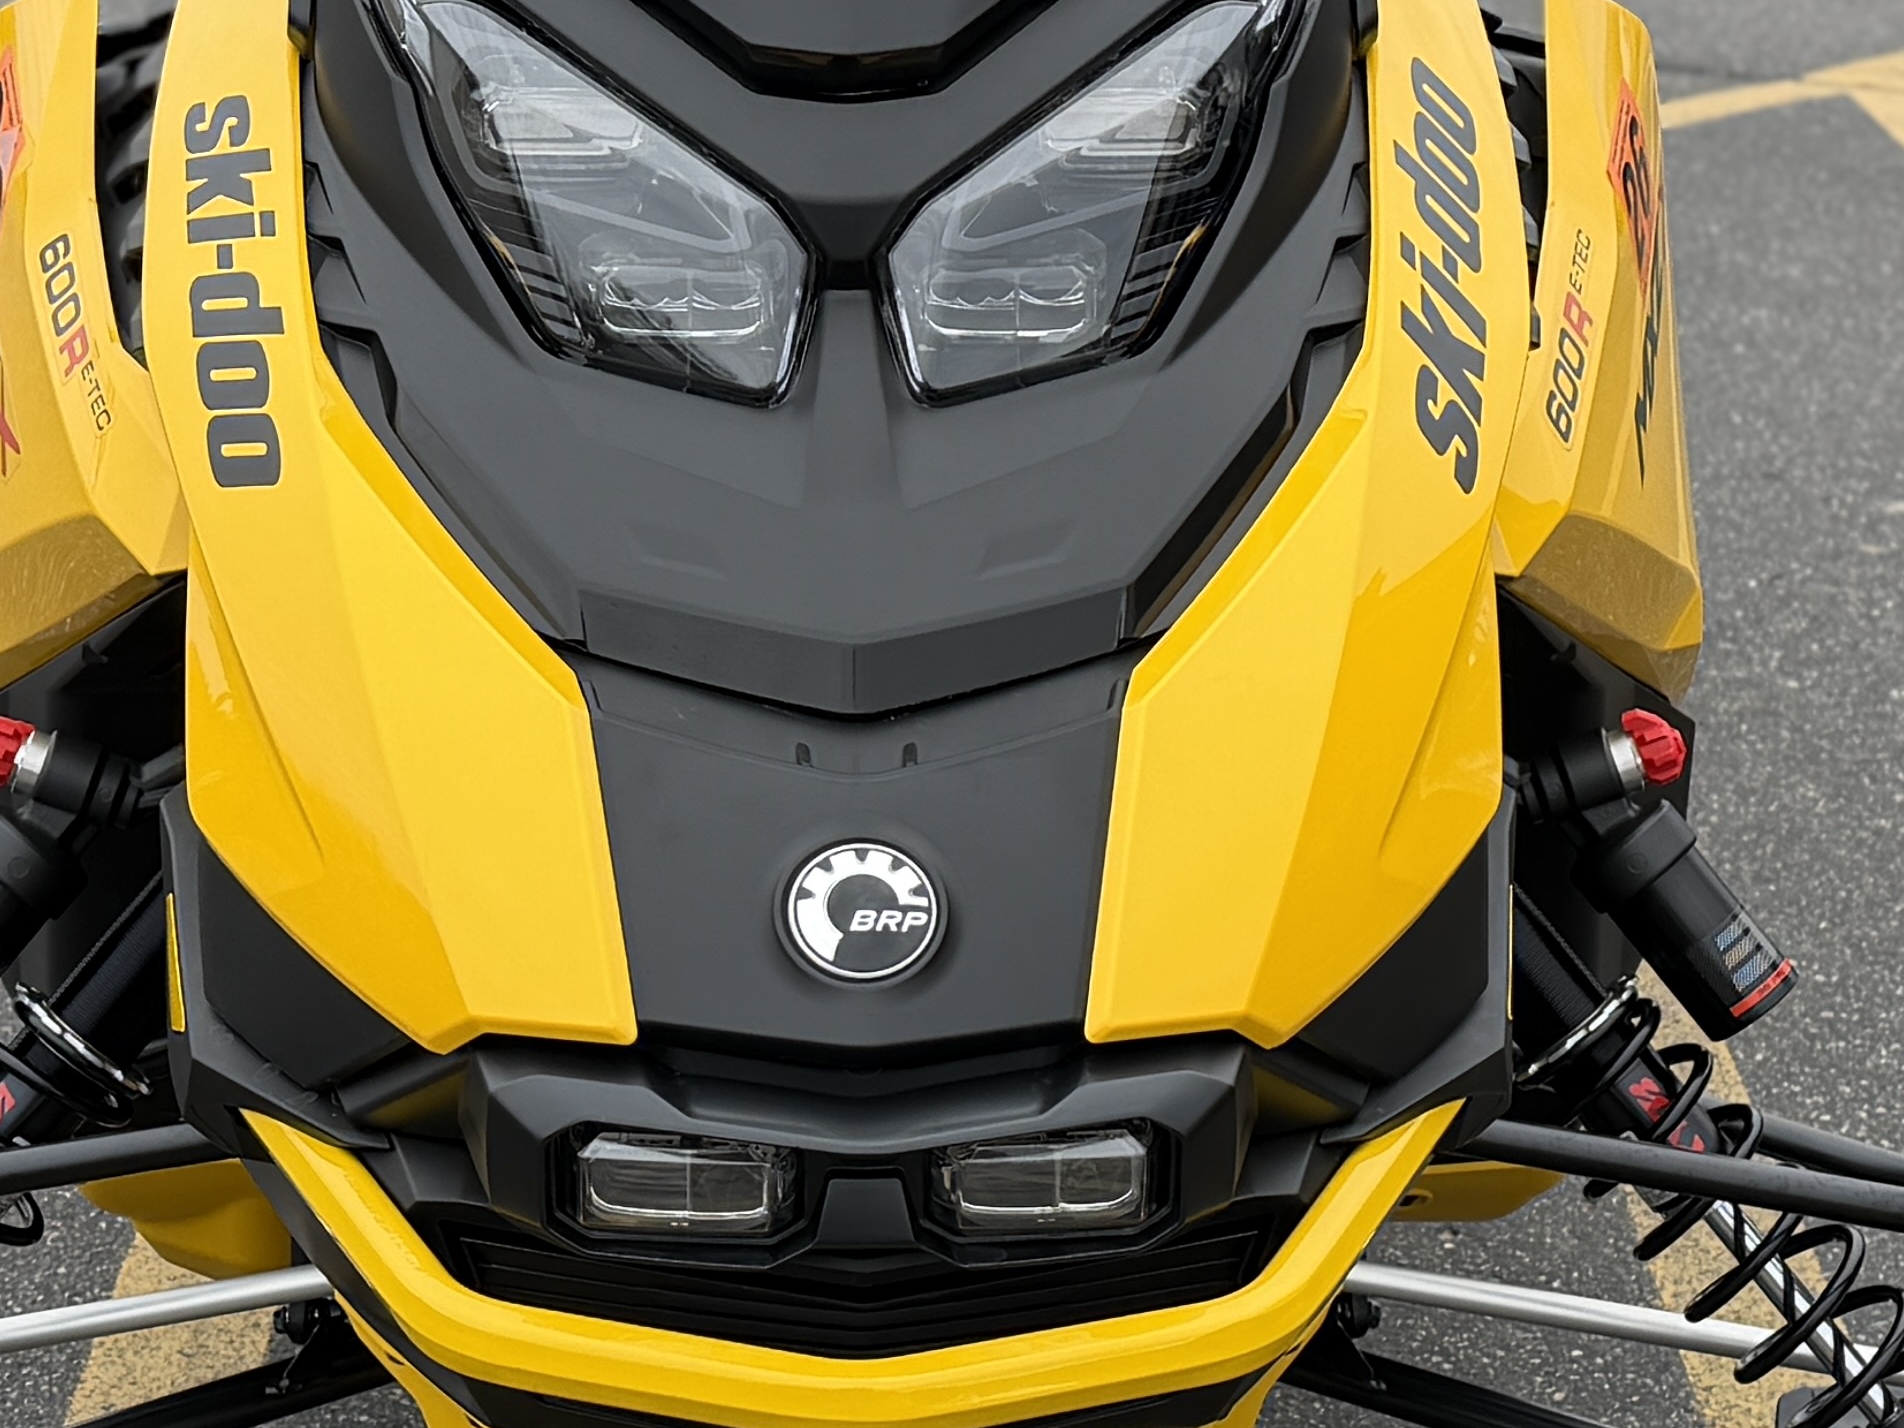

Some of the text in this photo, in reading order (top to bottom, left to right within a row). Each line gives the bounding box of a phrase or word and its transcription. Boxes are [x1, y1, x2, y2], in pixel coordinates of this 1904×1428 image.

[39, 233, 112, 431] 600R E-TEC
[184, 95, 285, 488] ski-doo
[1393, 57, 1487, 494] ski-doo
[1546, 228, 1594, 444] 600R E-TEC
[849, 909, 929, 933] BRP
